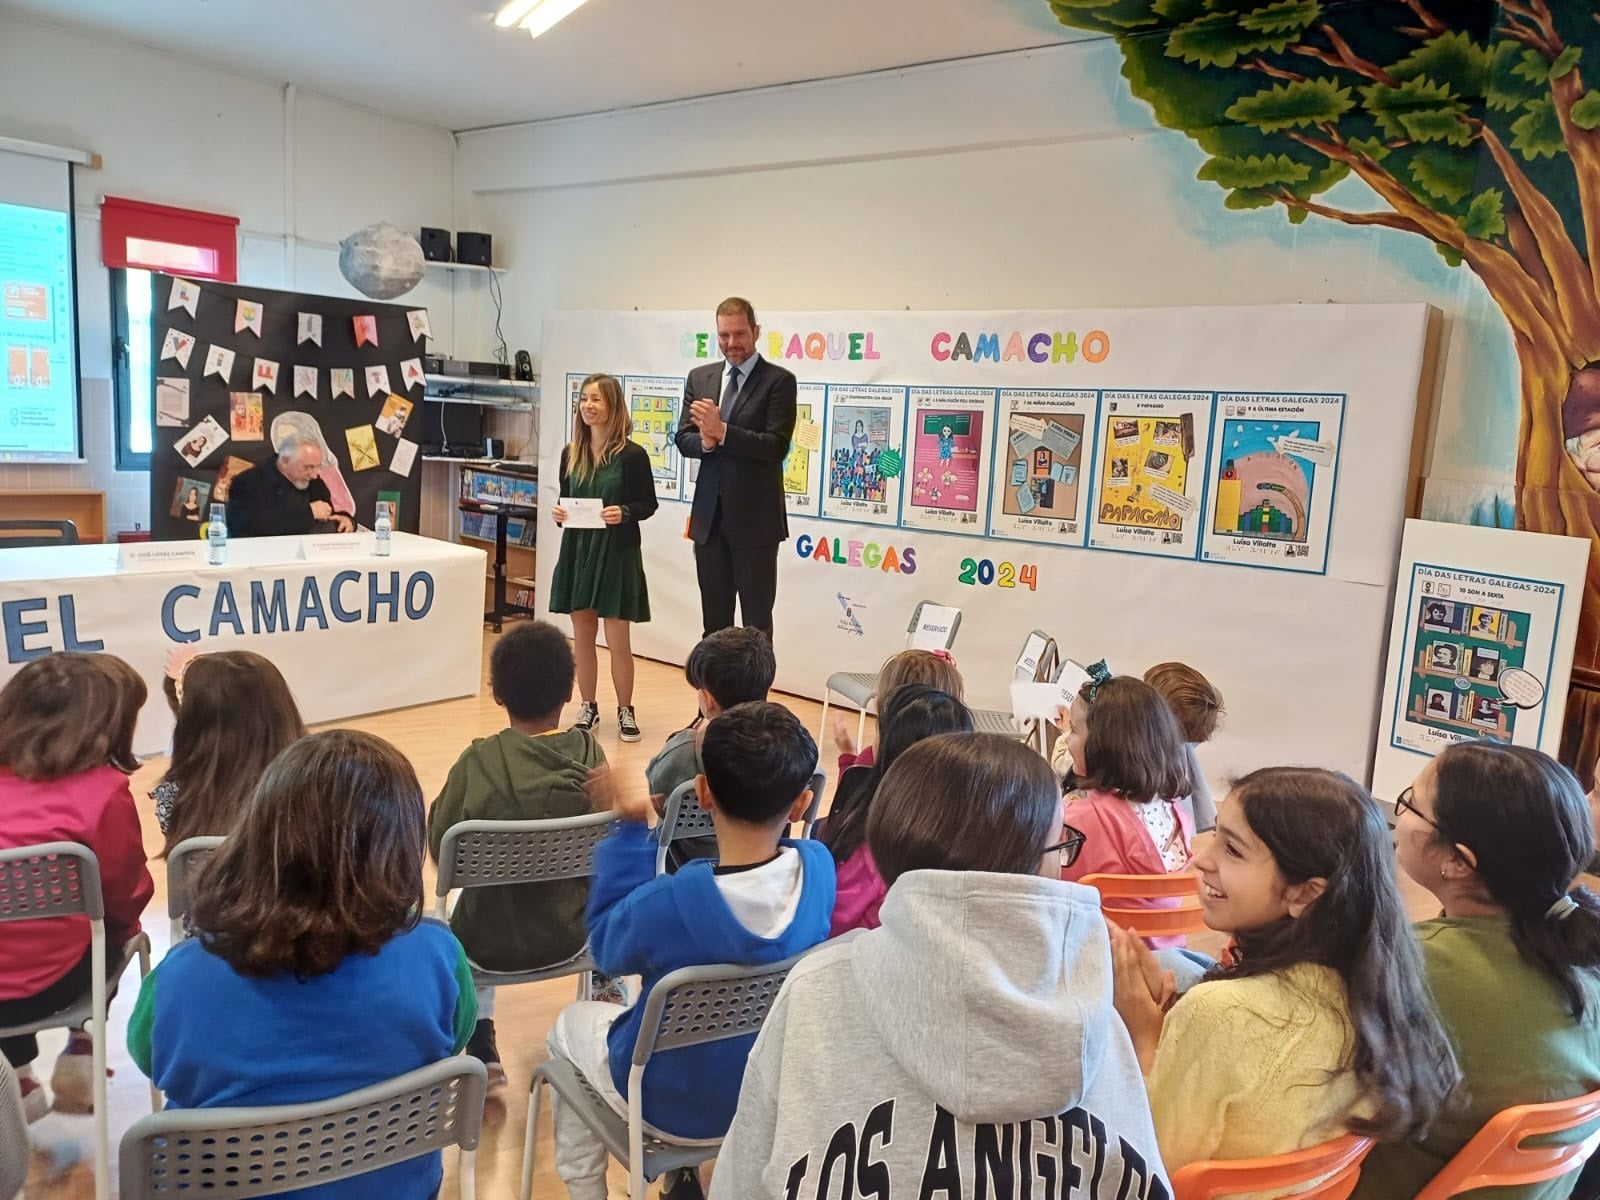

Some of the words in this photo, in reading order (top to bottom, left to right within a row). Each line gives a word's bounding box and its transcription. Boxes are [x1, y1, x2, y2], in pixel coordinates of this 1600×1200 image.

[681, 332, 721, 358] CEI
[768, 331, 880, 360] RAQUEL
[931, 330, 1110, 363] CAMACHO
[1220, 394, 1233, 402] DÍA
[1253, 539, 1276, 548] Villalta
[796, 534, 917, 575] GALEGAS
[958, 557, 1038, 591] 2024
[1418, 568, 1432, 576] DÍA
[1453, 572, 1486, 584] LETRAS
[1488, 578, 1531, 591] GALEGAS
[1533, 585, 1556, 594] 2024
[161, 570, 435, 644] CAMACHO
[1428, 728, 1447, 739] Luísa
